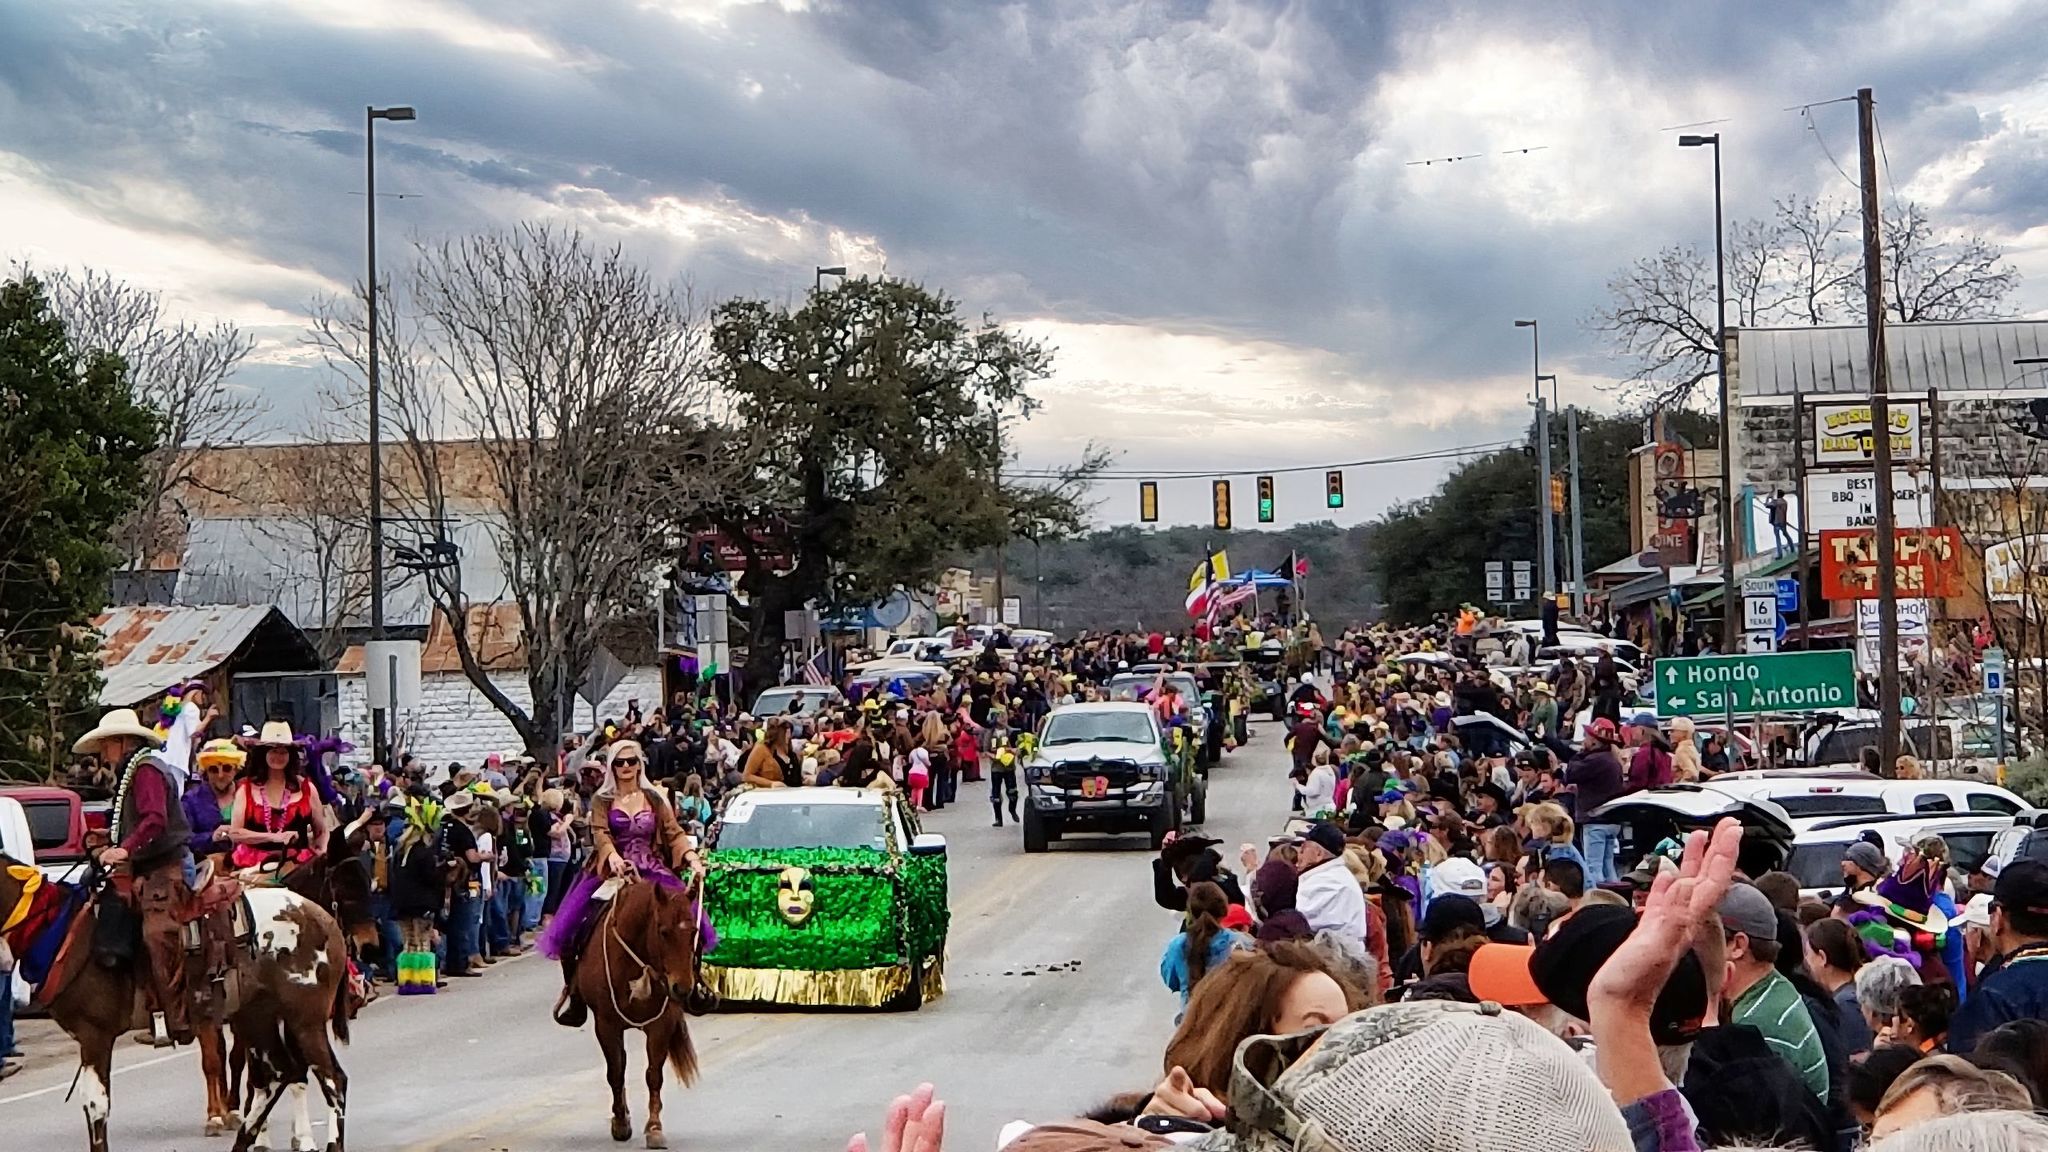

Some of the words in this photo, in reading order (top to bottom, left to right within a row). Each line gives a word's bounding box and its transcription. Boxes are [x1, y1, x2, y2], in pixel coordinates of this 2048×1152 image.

[1847, 478, 1873, 489] BEST
[1832, 491, 1854, 502] BBQ
[1860, 502, 1872, 514] IN
[1855, 565, 1924, 590] TRE
[1745, 580, 1775, 591] SOUTH
[1752, 601, 1768, 615] 16
[1688, 662, 1759, 683] Hondo
[1696, 690, 1738, 709] San
[1751, 682, 1842, 707] Antonio
